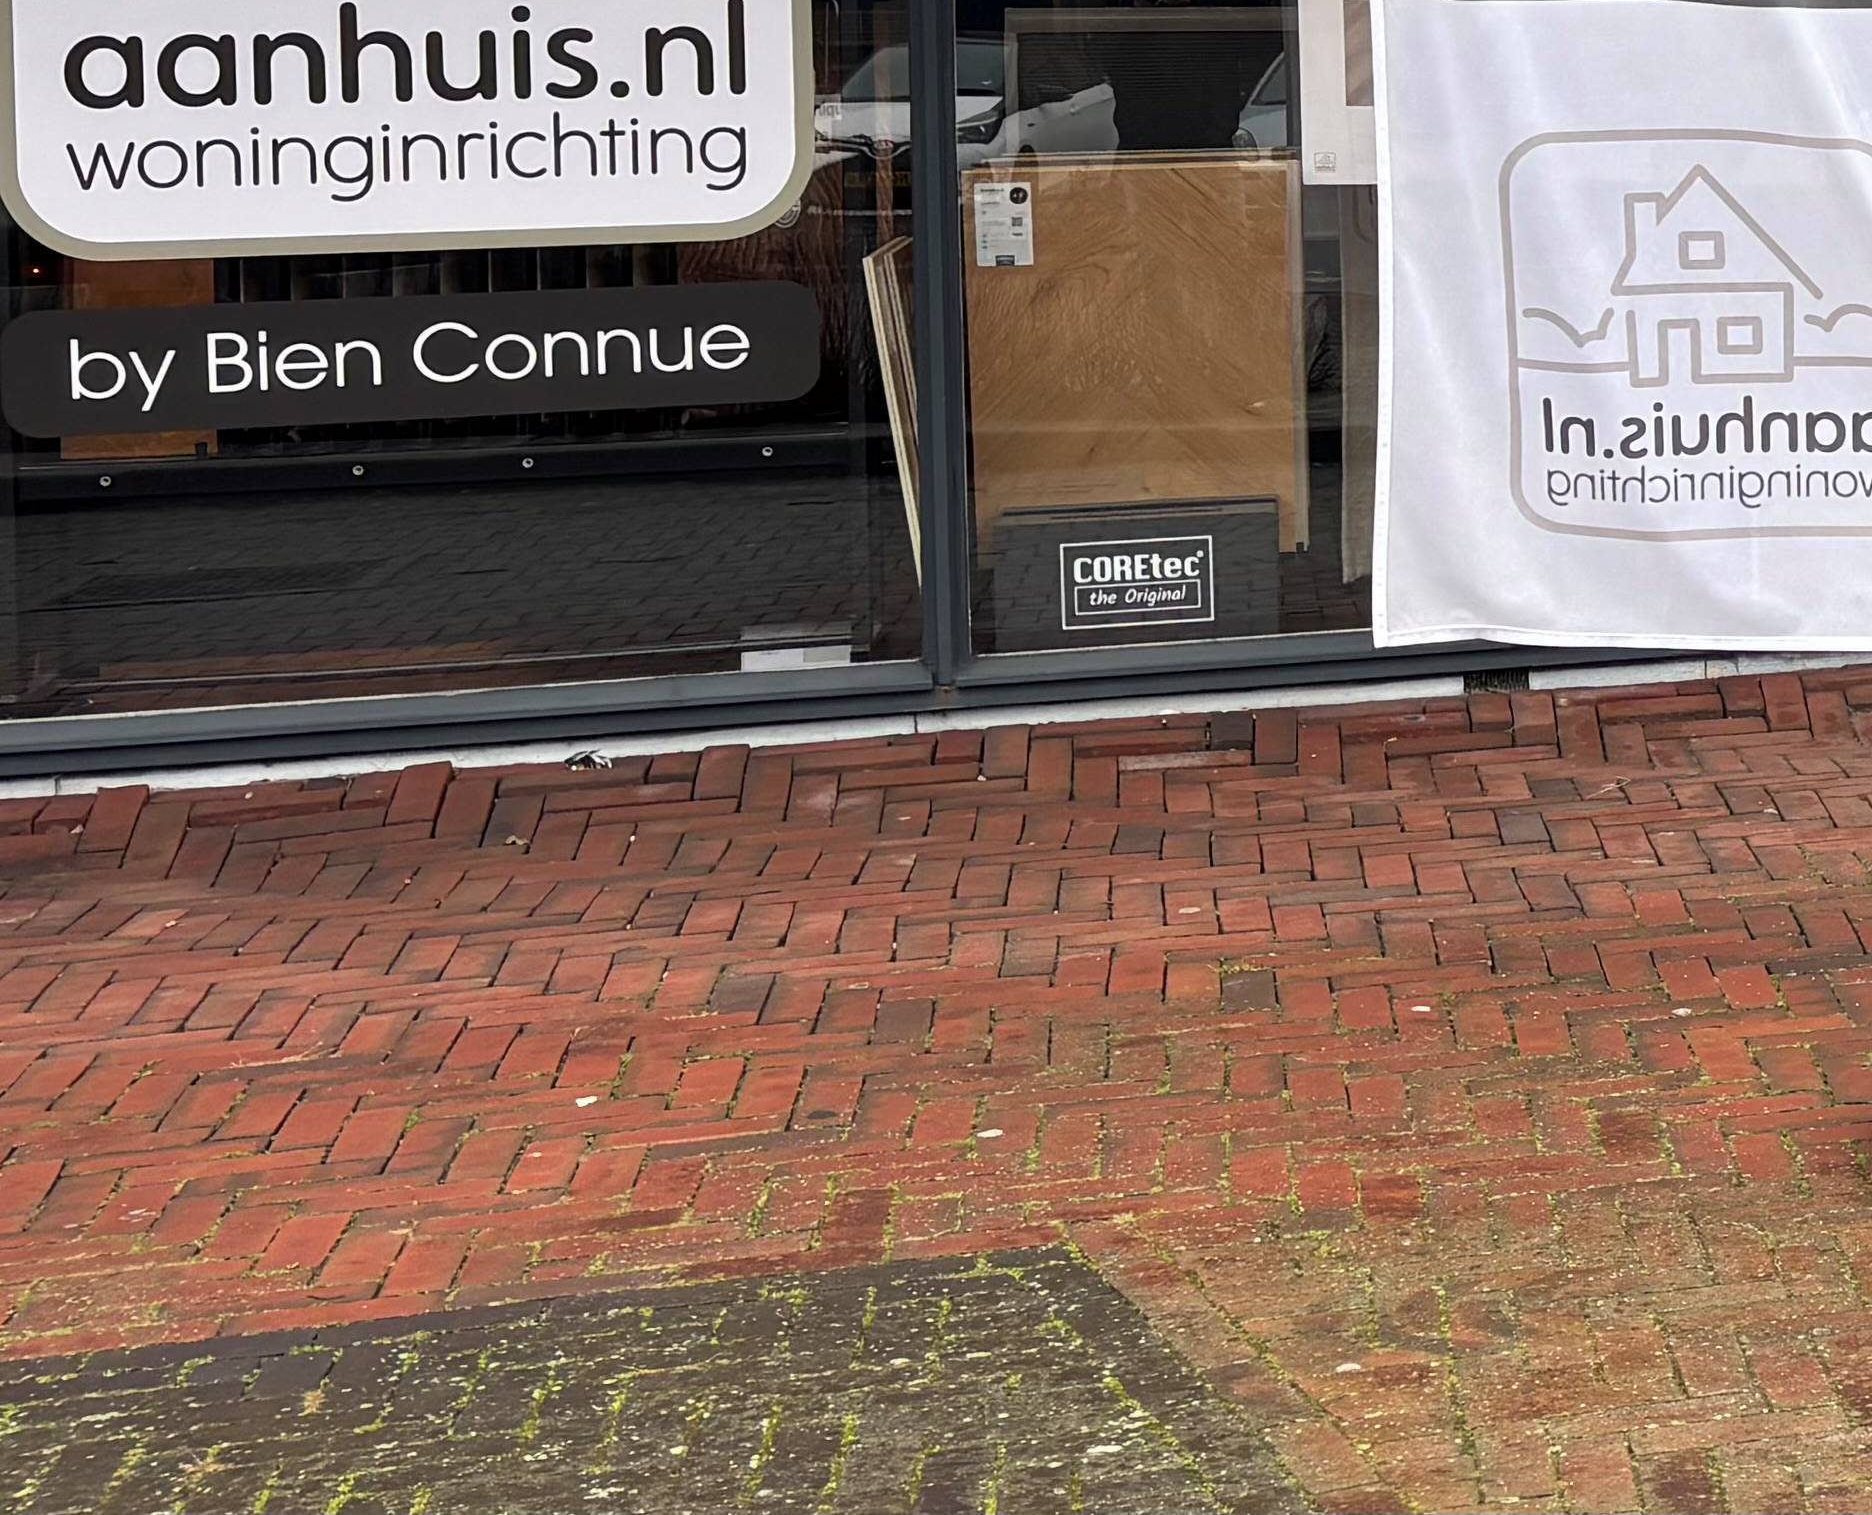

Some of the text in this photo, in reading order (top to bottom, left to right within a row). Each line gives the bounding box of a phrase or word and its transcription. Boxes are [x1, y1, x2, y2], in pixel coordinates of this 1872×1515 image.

[66, 112, 747, 202] woninginrichting
[70, 321, 750, 412] by Bien Connue
[1073, 553, 1201, 584] COREtec
[1089, 584, 1187, 607] the Original
